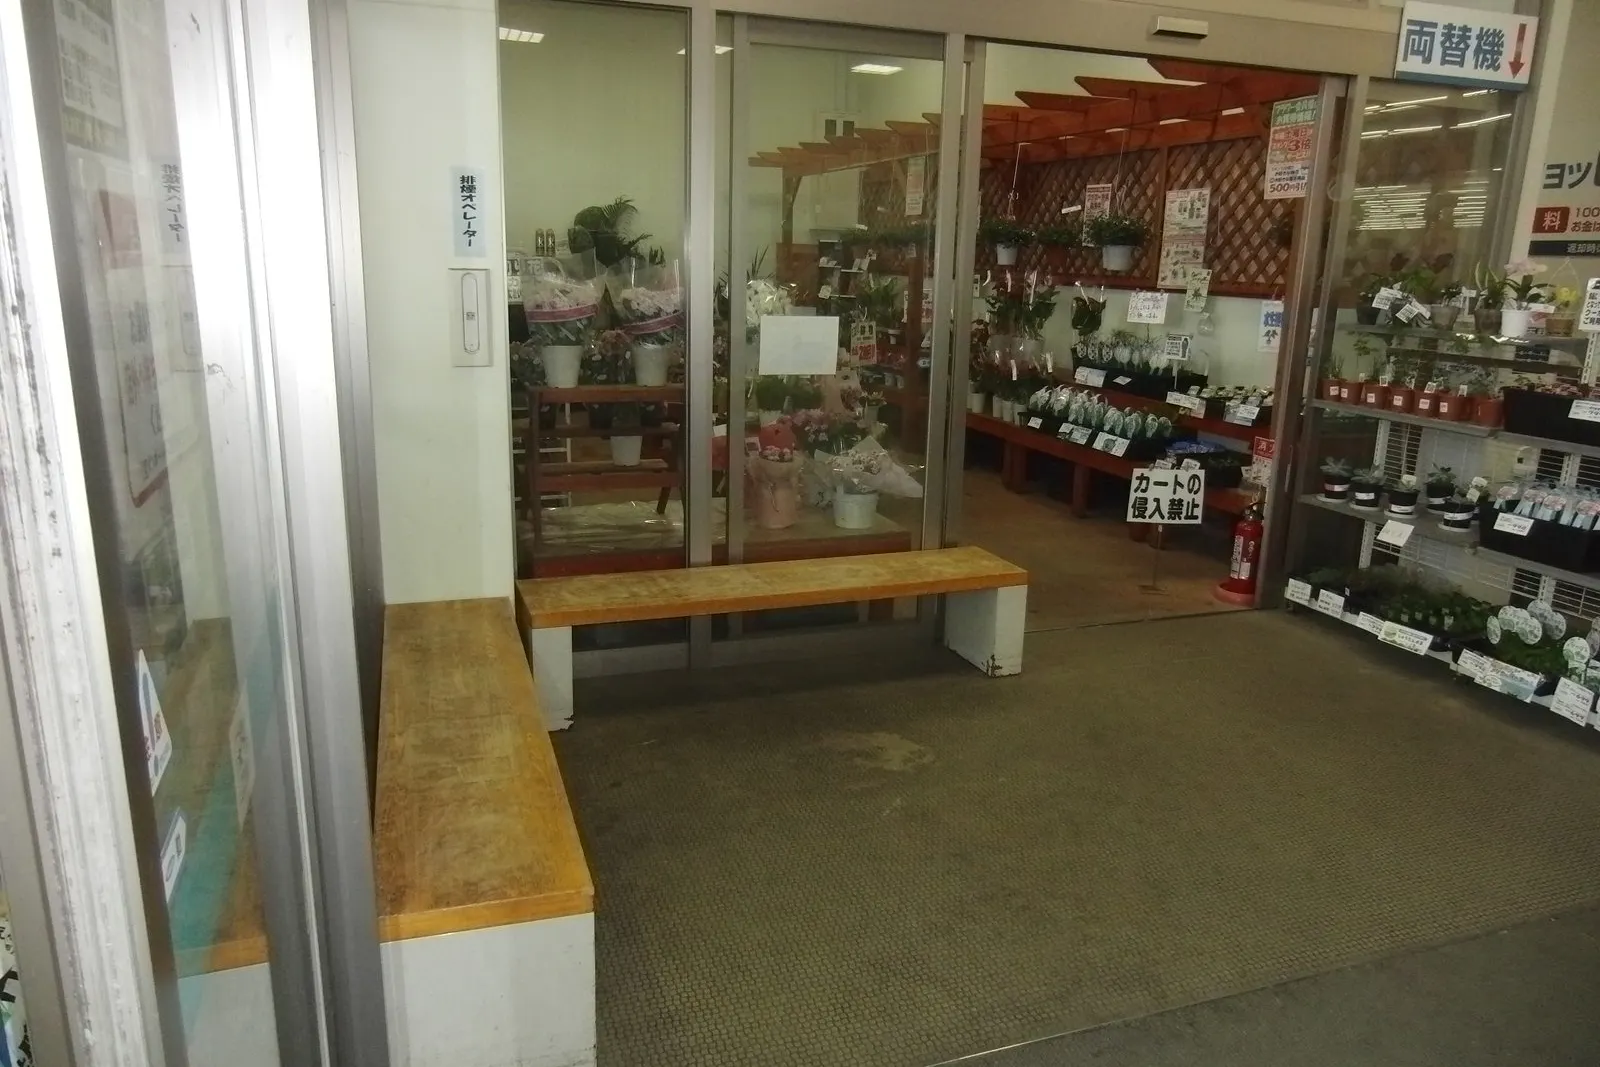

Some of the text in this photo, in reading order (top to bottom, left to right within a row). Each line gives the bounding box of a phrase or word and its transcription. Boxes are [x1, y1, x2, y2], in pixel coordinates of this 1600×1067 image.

[1402, 18, 1505, 72] 両替機
[459, 175, 478, 248] 排煙オペレーター
[1133, 473, 1201, 495] カートの
[1131, 496, 1200, 521] 侵入禁止
